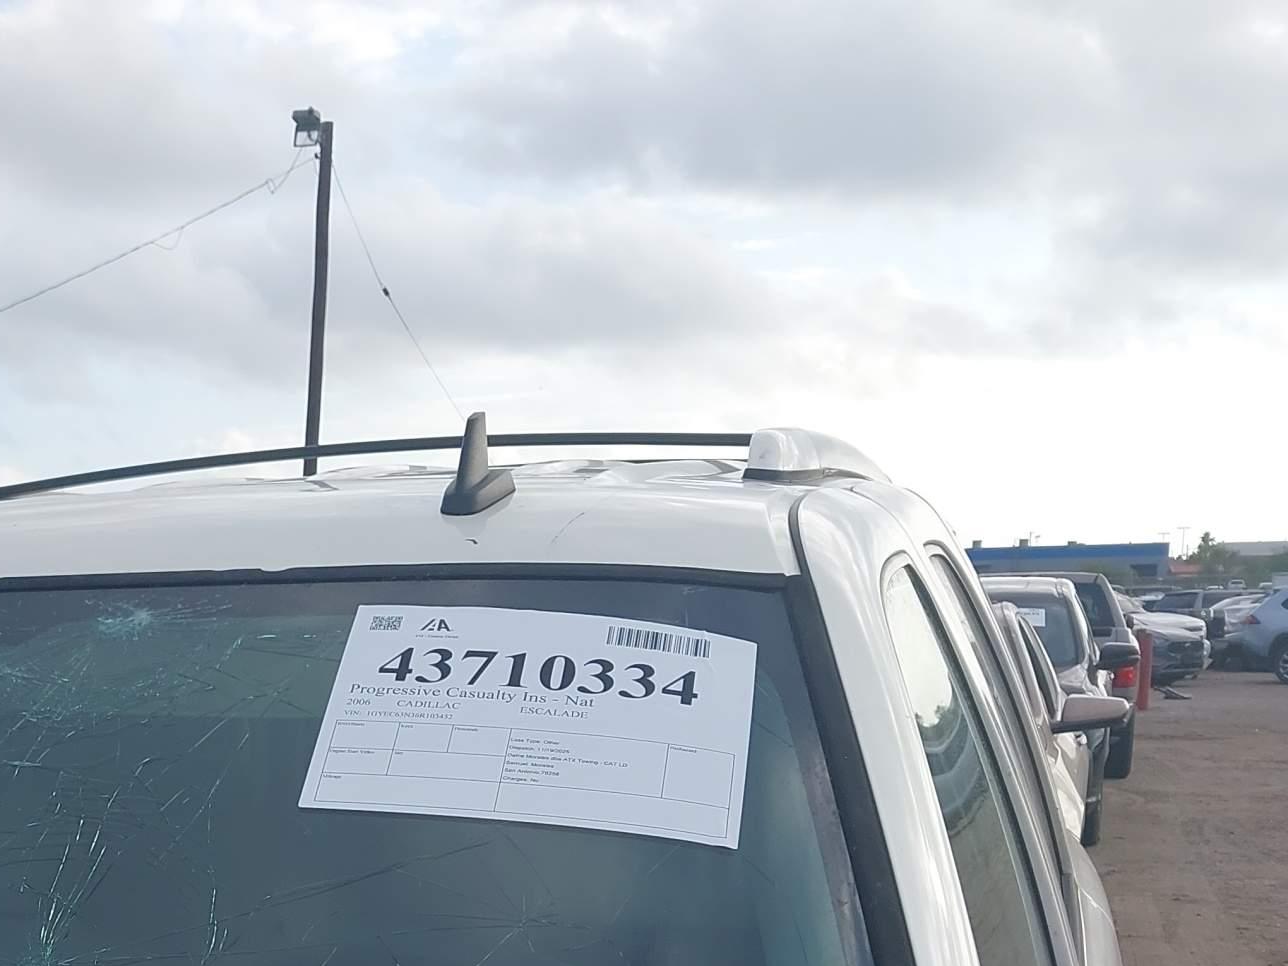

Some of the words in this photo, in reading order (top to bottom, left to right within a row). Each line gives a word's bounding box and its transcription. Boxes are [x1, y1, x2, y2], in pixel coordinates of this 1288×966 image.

[378, 647, 699, 706] 43710334
[349, 683, 441, 698] Progressive
[445, 686, 518, 704] Casualty
[523, 691, 547, 704] Ins
[564, 695, 595, 708] Nat
[346, 698, 371, 707] 2006
[396, 699, 461, 710] CADILLAC
[519, 706, 589, 719] ESCALADE
